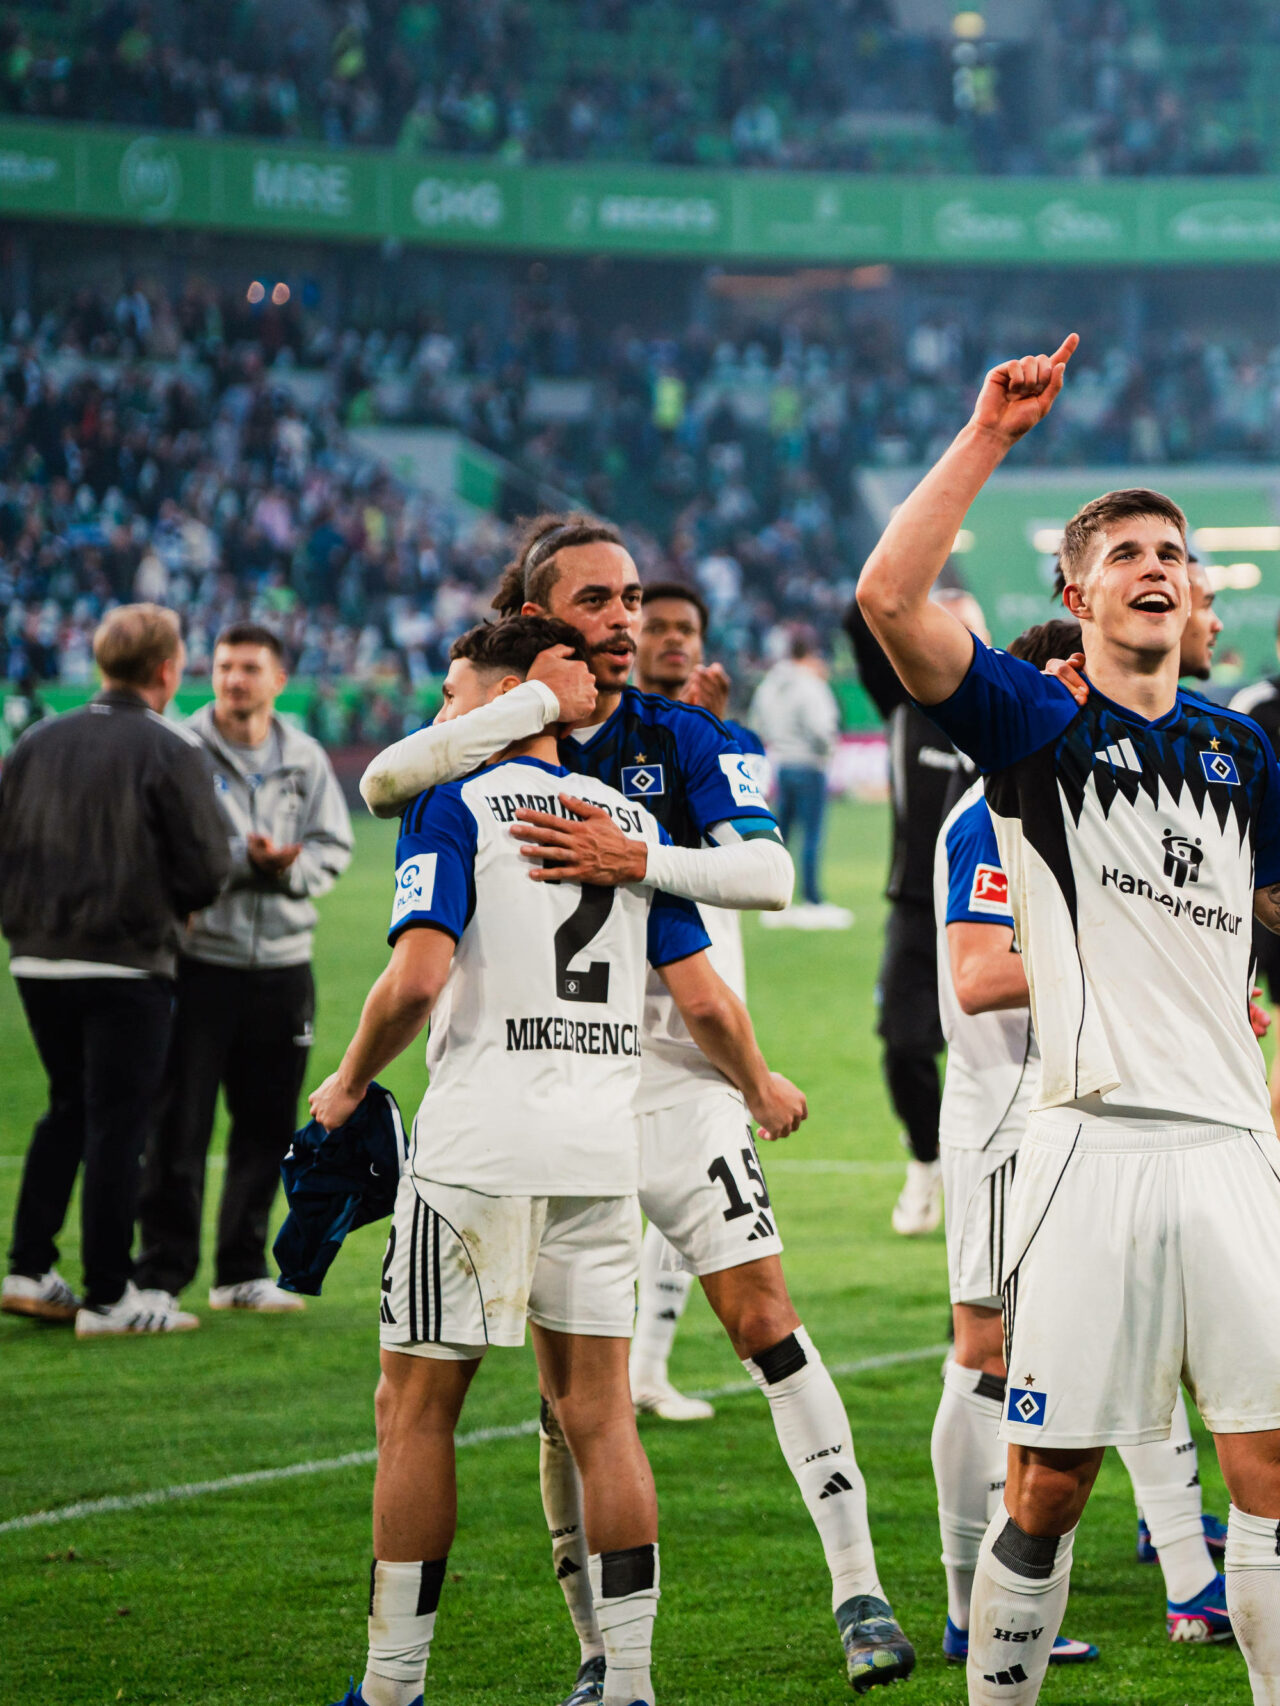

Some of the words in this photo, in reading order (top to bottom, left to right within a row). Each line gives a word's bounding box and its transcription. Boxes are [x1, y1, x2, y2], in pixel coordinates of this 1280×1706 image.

[616, 806, 643, 833] SV
[542, 842, 615, 1004] 2
[707, 1148, 770, 1222] 15
[993, 1625, 1045, 1643] HSV
